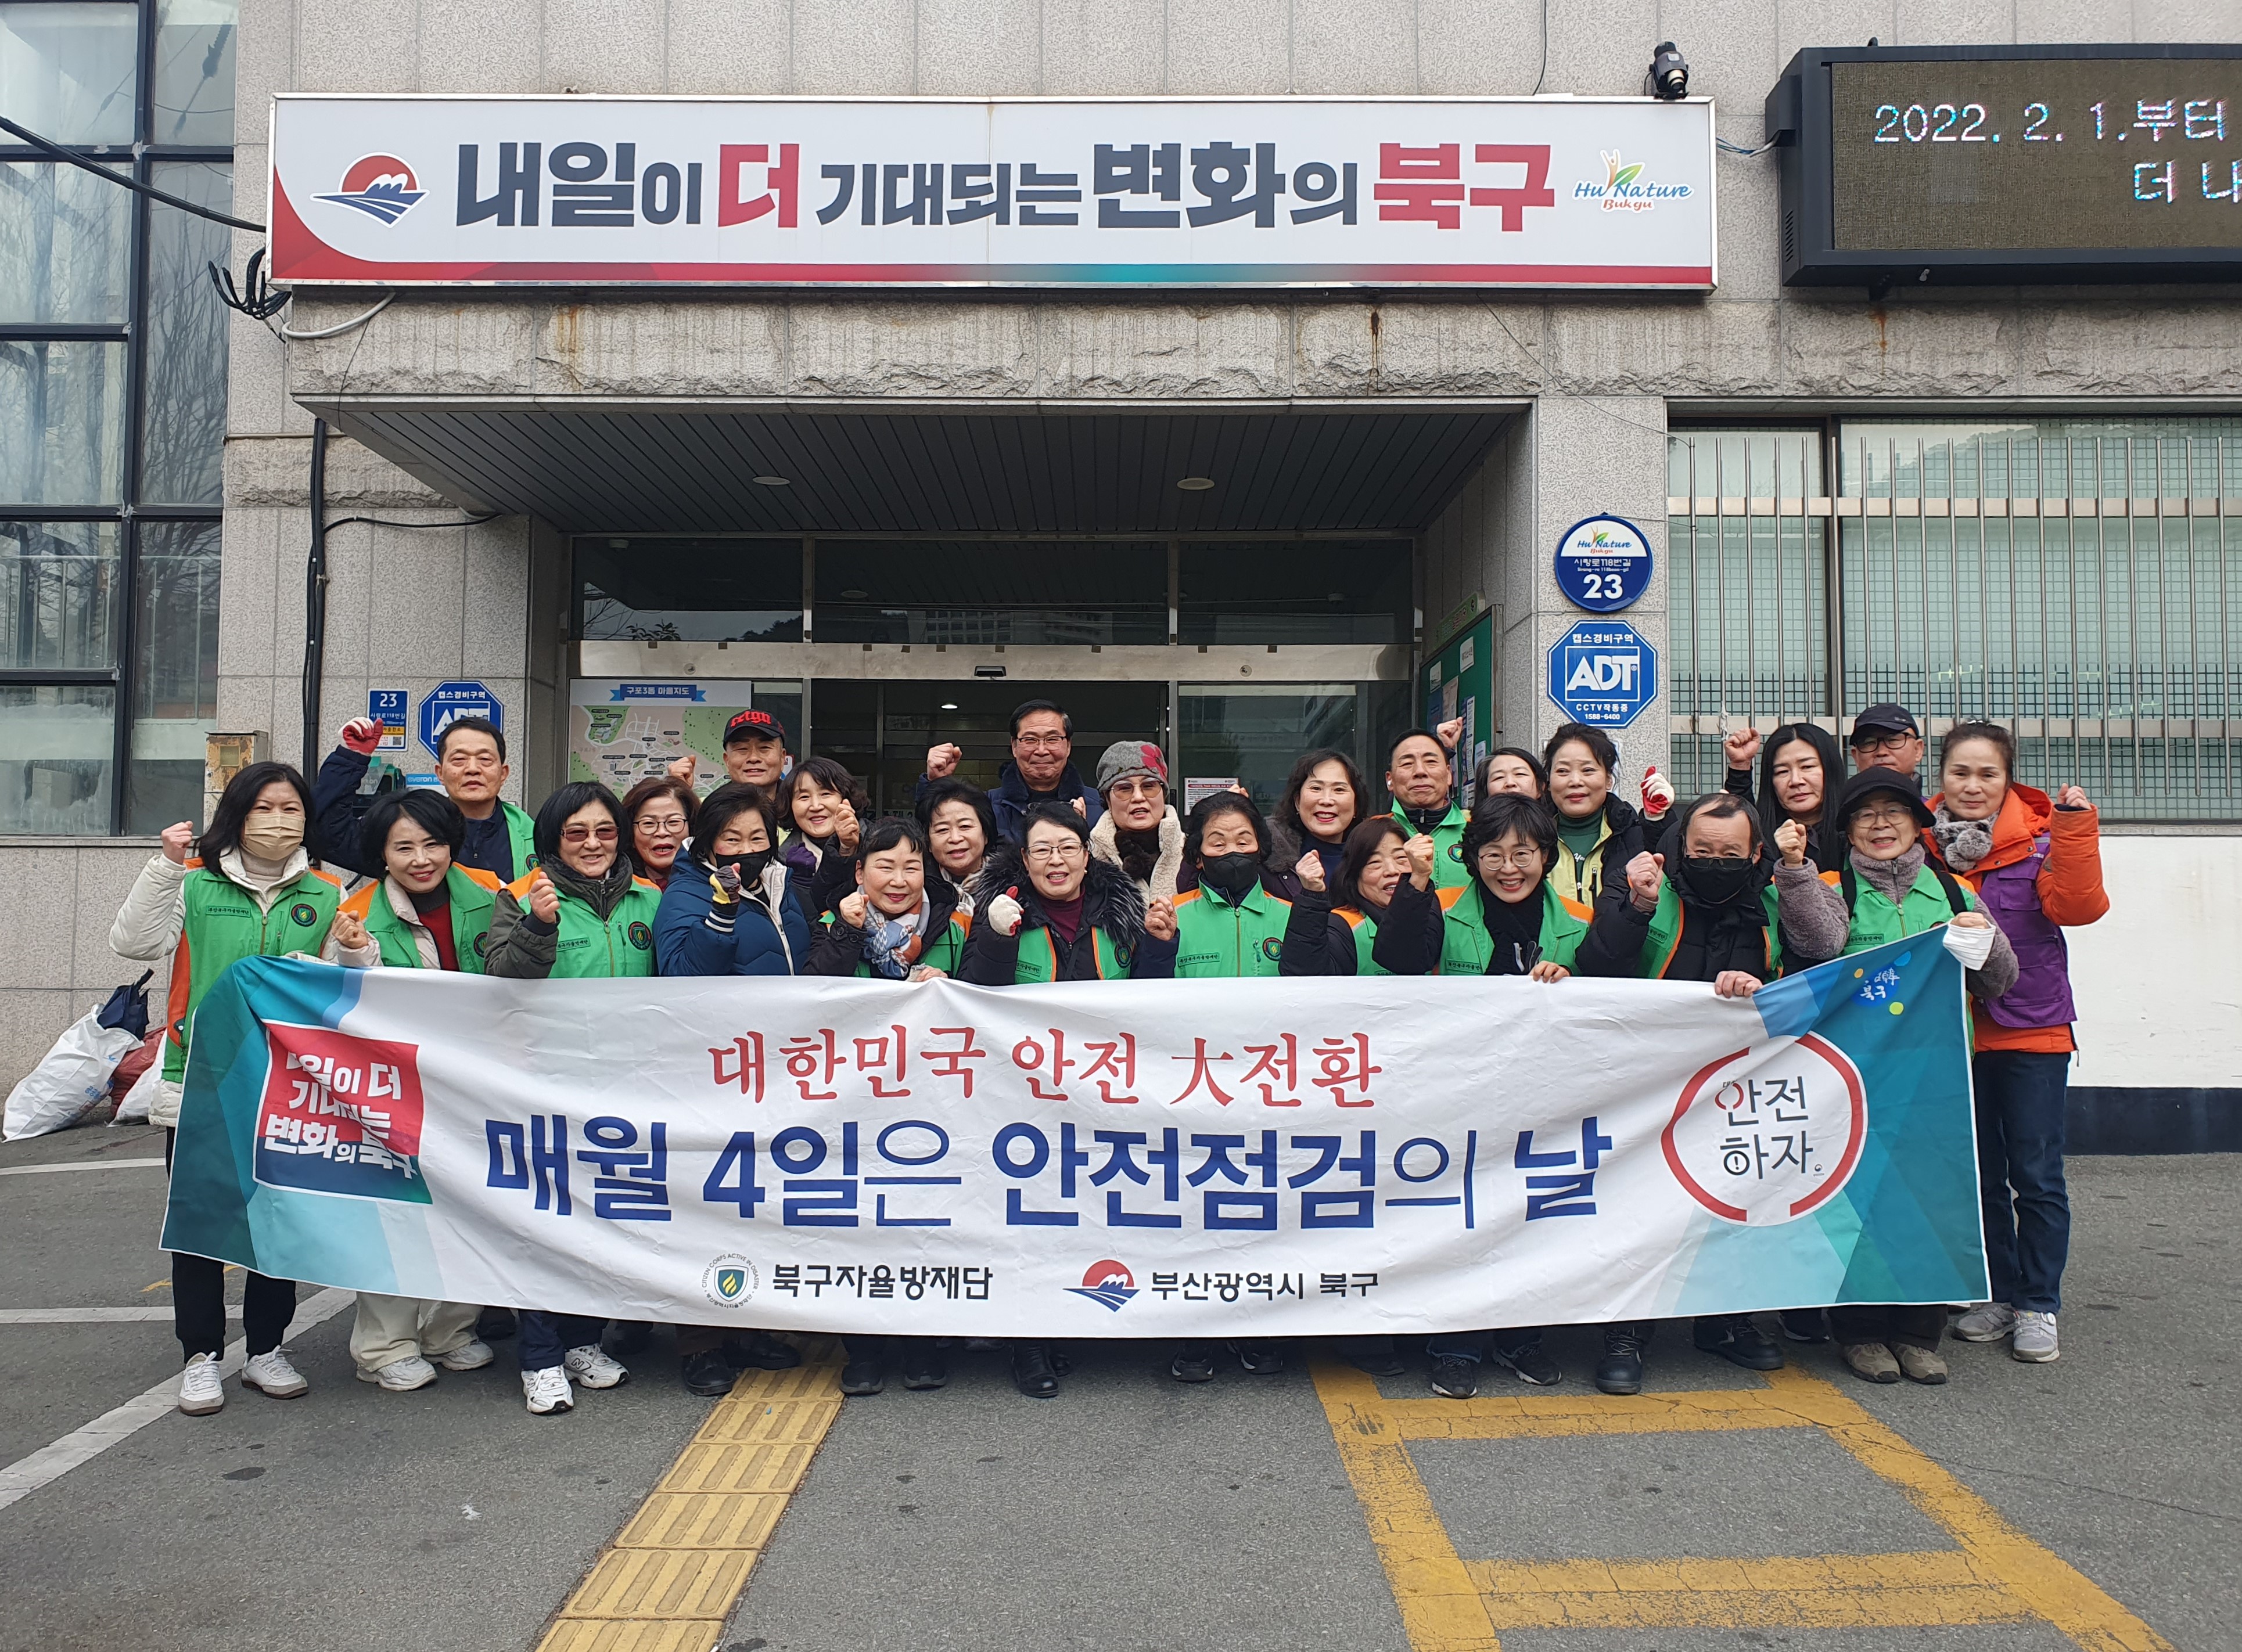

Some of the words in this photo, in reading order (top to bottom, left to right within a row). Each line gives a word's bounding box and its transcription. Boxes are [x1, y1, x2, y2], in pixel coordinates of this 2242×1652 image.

[1875, 104, 2000, 142] 2022.
[2024, 103, 2063, 142] 2.
[456, 142, 702, 227] 내일이
[718, 143, 800, 228] 더
[815, 163, 1082, 226] 기대되는
[1093, 141, 1357, 229] 변화의
[1374, 143, 1555, 232] 북구
[1575, 182, 1605, 197] Hu
[1614, 182, 1693, 197] Nature
[2134, 160, 2173, 203] 더
[1595, 539, 1632, 548] Nature
[1583, 574, 1623, 599] 23
[1572, 634, 1633, 643] 캡스경비구역
[1567, 655, 1638, 691] ADT
[379, 693, 397, 707] 23
[1576, 703, 1628, 712] CCTV작동중
[367, 1062, 401, 1100] 더
[708, 1024, 986, 1104] 대한민국
[1012, 1028, 1140, 1104] 안전
[1170, 1032, 1382, 1108] 大전환
[1715, 1076, 1809, 1126] 안전
[486, 1114, 672, 1222] 매월
[703, 1120, 962, 1227] 4일은
[992, 1122, 1477, 1230] 안전점검의
[1515, 1115, 1613, 1222] 날
[1720, 1131, 1813, 1179] 하자
[709, 1254, 727, 1268] CORPS
[727, 1253, 747, 1262] ACTIVE
[750, 1265, 760, 1290] DISASTER
[773, 1264, 993, 1301] 북구자율방재단
[1151, 1272, 1304, 1303] 부산광역시
[1320, 1272, 1379, 1298] 북구
